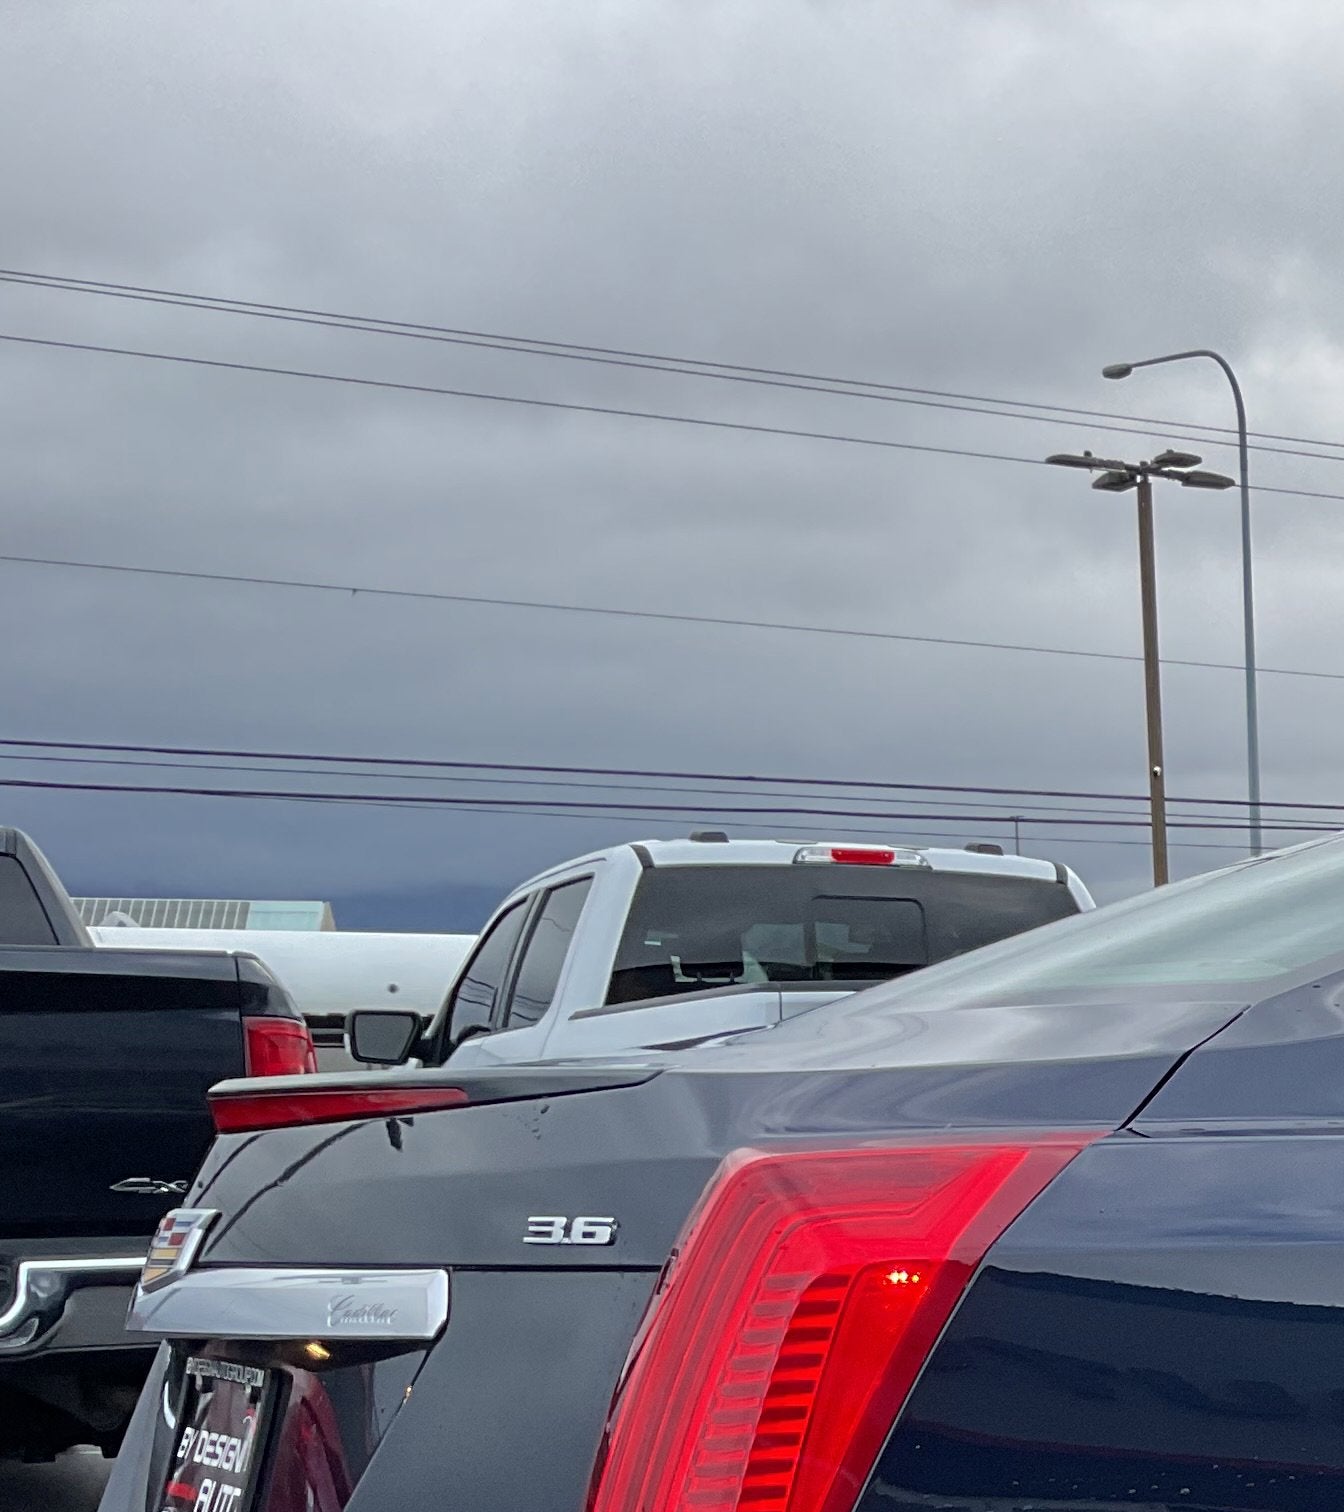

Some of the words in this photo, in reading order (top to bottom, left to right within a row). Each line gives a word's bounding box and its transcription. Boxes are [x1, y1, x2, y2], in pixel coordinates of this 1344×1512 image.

[523, 1216, 617, 1244] 3.6
[327, 1294, 398, 1328] Cadillac
[177, 1427, 199, 1458] BY
